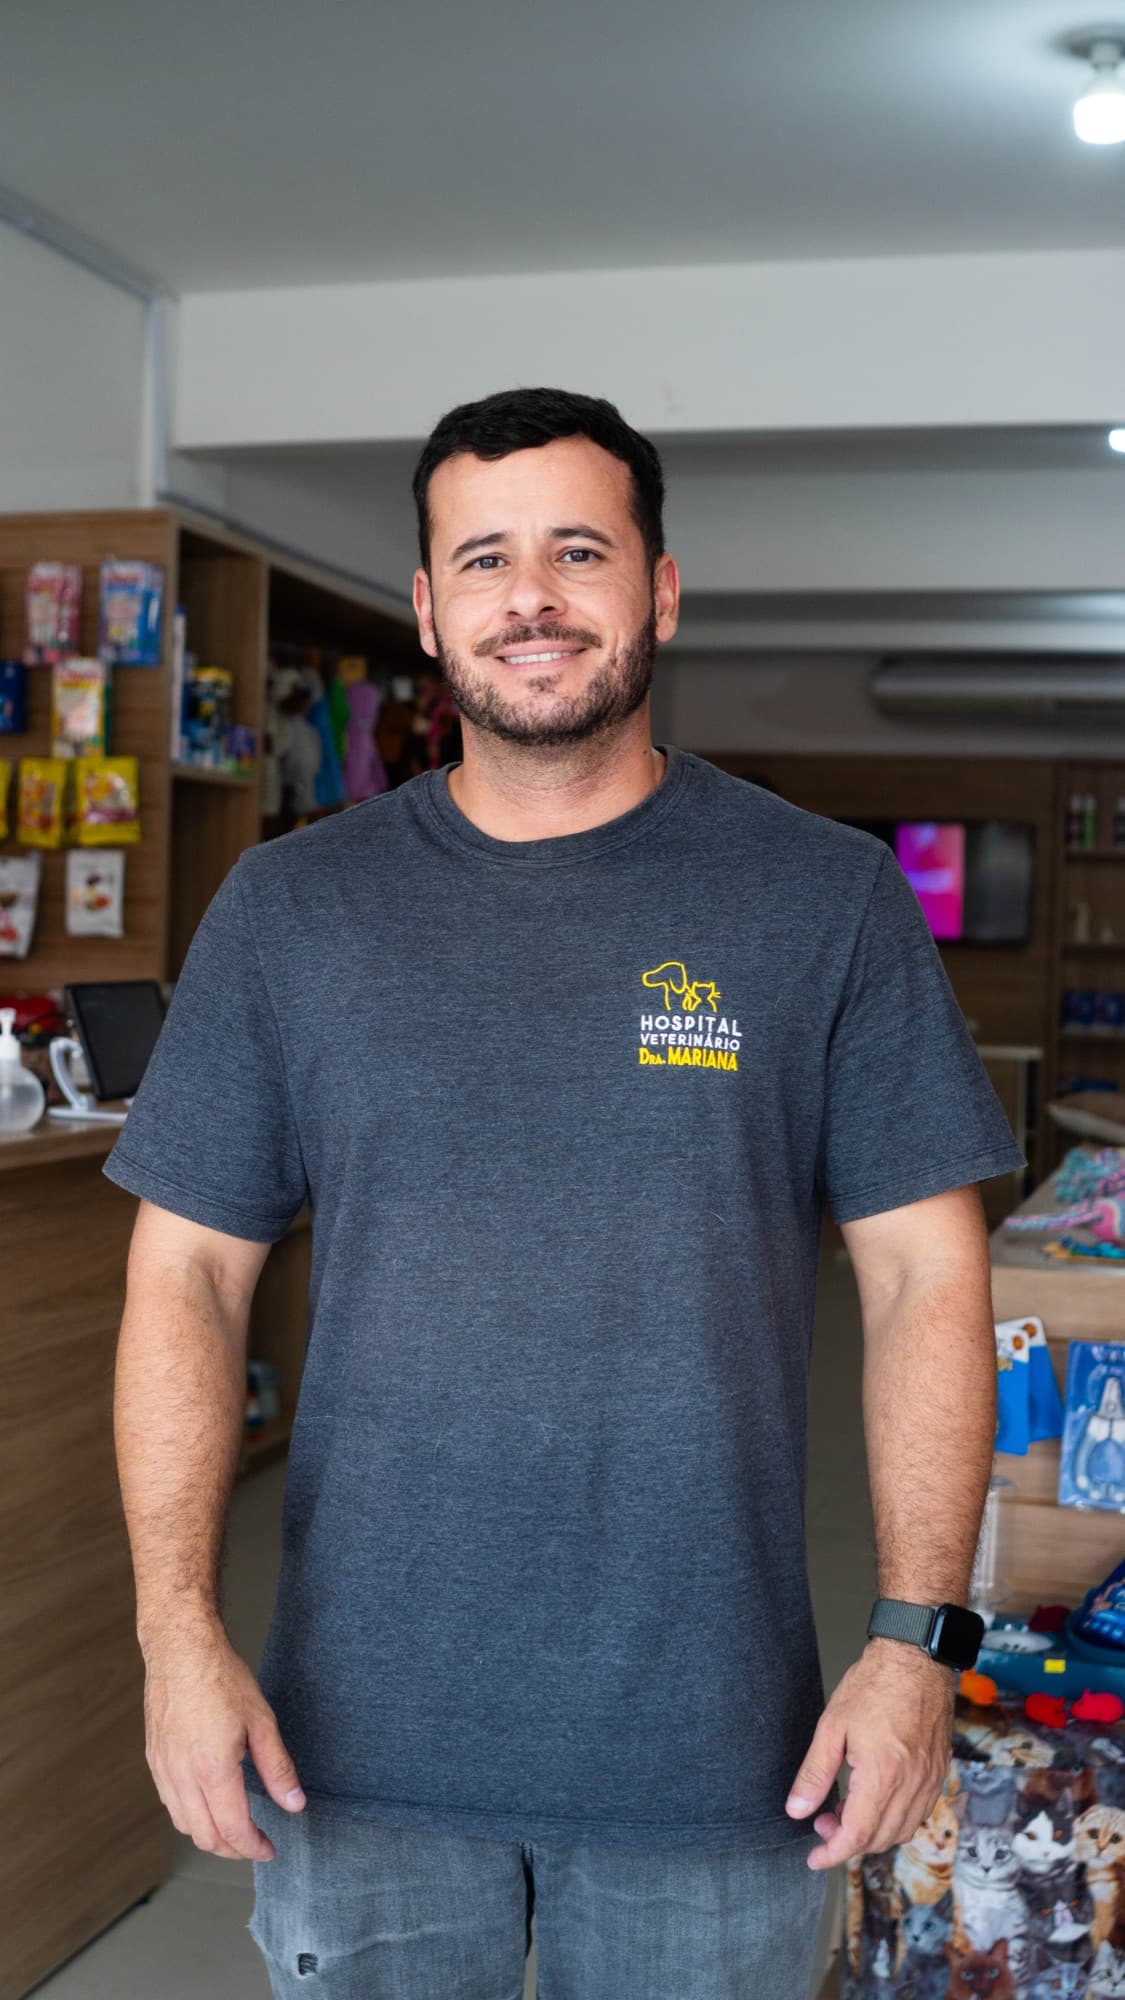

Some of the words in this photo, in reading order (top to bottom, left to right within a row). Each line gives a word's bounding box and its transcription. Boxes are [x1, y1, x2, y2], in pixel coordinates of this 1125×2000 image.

[641, 1015, 742, 1036] HOSPITAL
[641, 1033, 740, 1051] VETERINÁRIO
[668, 1046, 738, 1071] MARIANA
